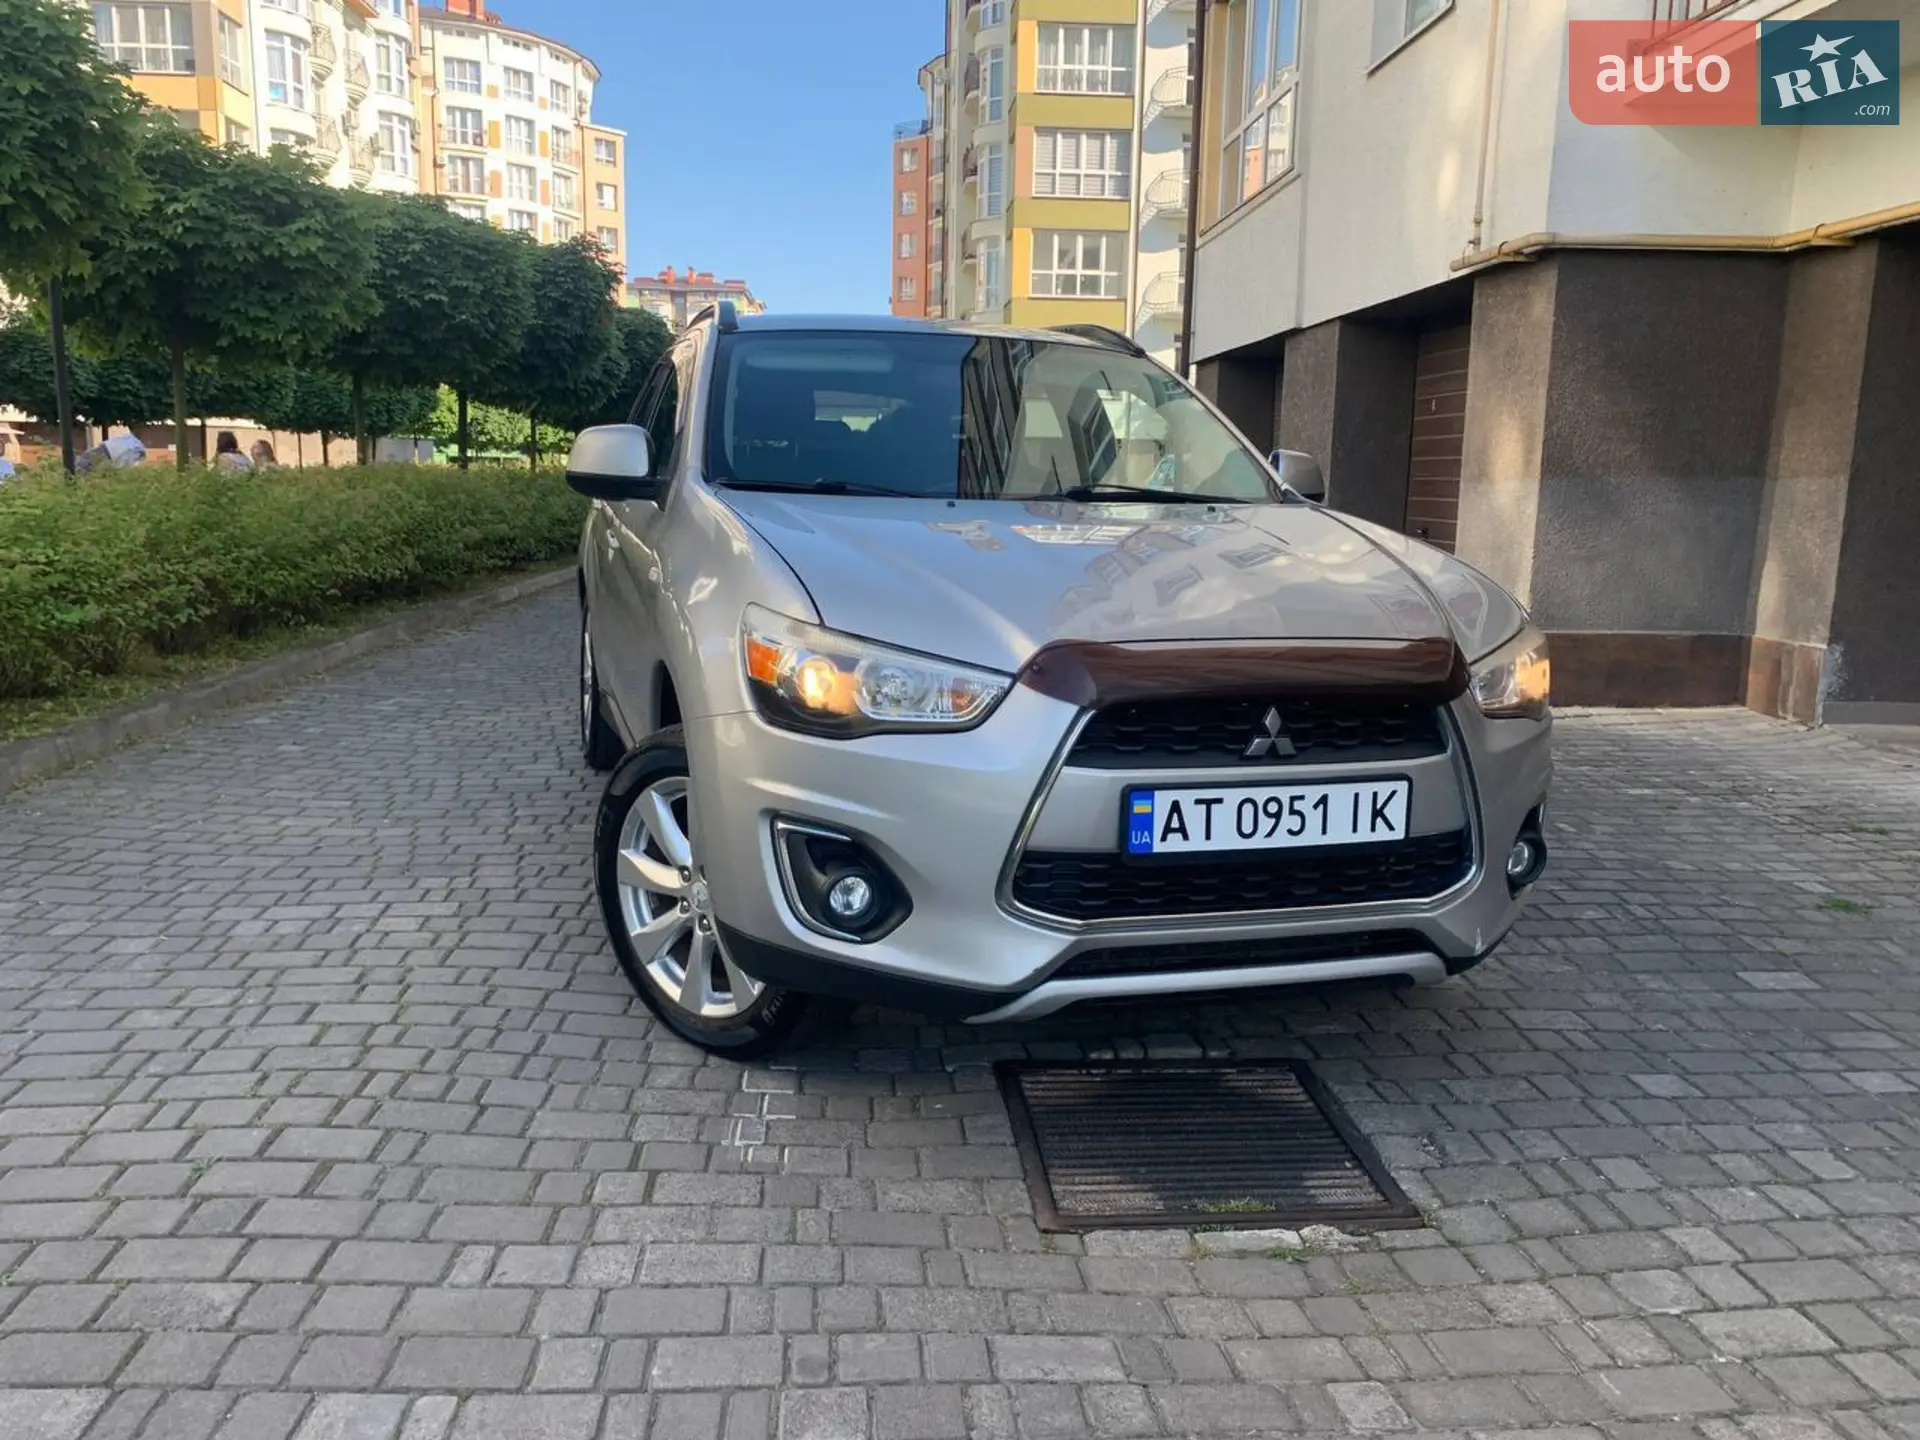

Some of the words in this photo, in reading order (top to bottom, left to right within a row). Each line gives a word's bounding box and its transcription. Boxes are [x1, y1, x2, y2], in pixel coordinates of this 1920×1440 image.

[1160, 798, 1224, 843] AT
[1236, 793, 1329, 839] 0951
[1352, 789, 1398, 833] IK
[1131, 829, 1151, 845] UA
